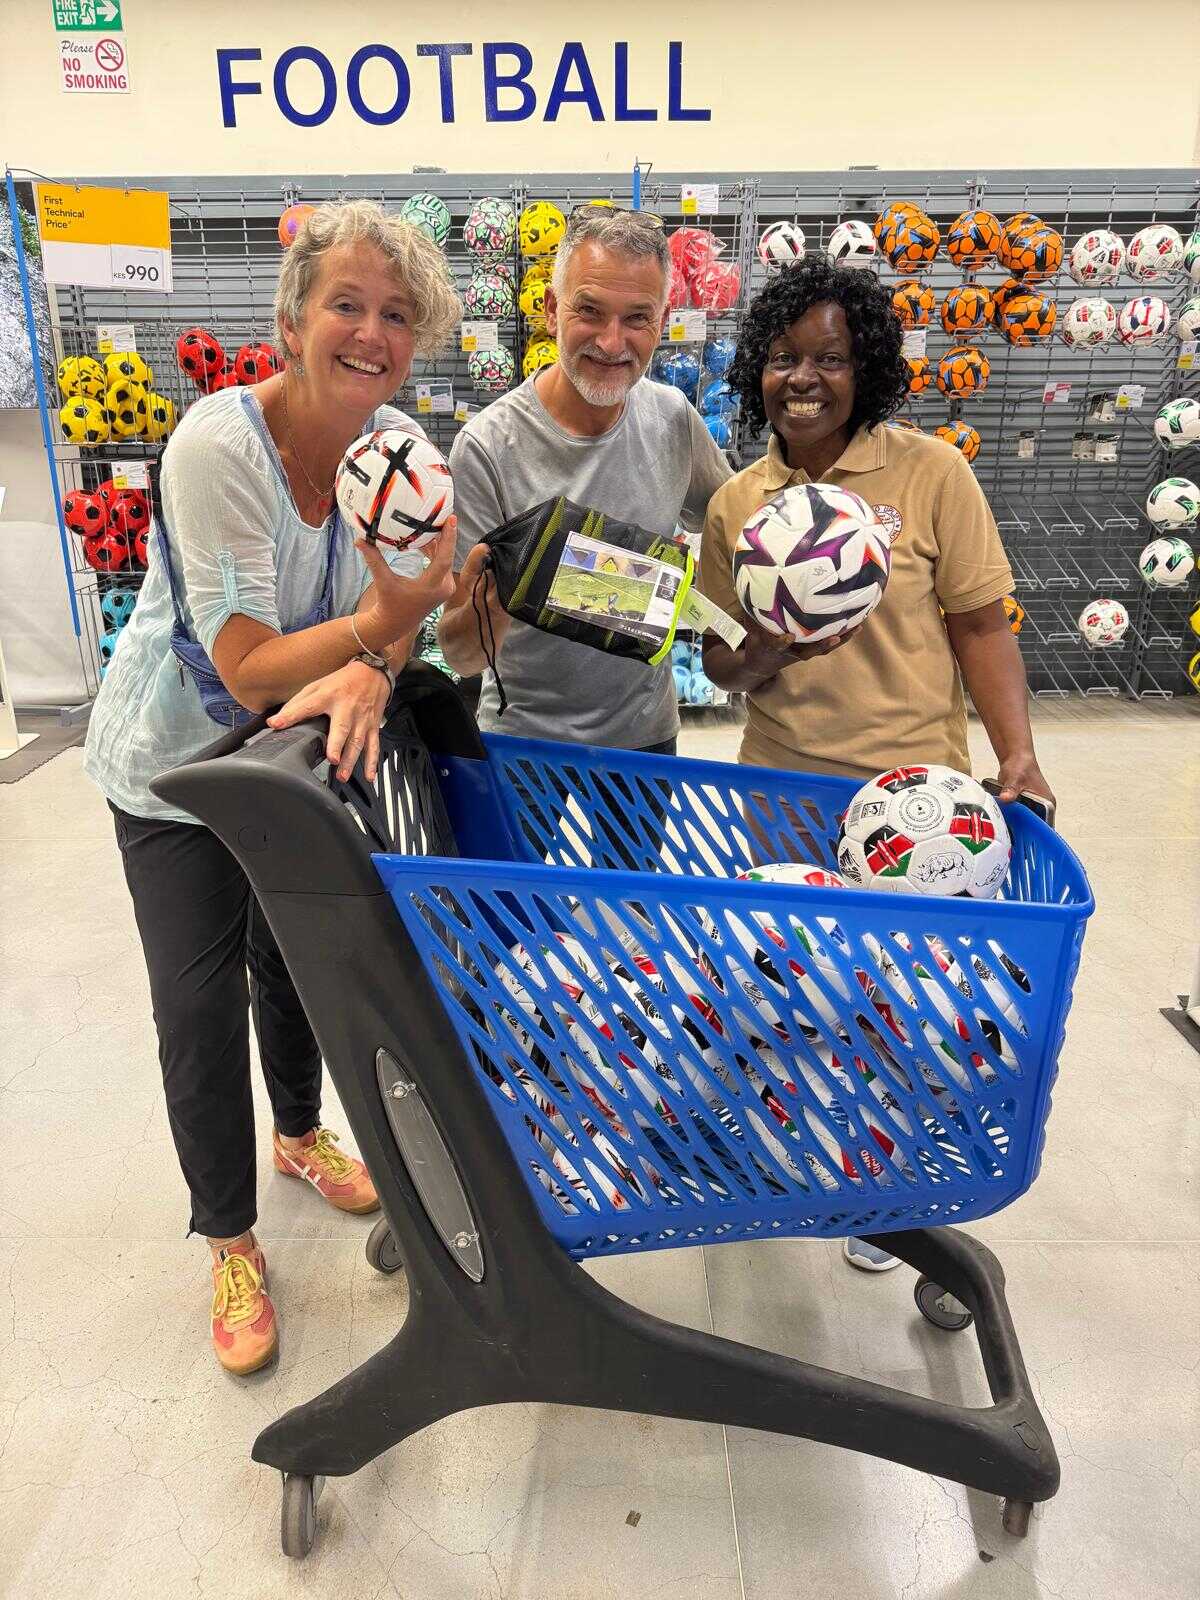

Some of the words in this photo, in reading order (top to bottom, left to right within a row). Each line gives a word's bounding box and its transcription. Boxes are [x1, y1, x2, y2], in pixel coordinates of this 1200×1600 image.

[55, 0, 78, 11] FIRE
[57, 11, 79, 26] EXIT
[61, 40, 94, 53] Please
[63, 58, 81, 71] NO
[65, 74, 127, 89] SMOKING
[216, 41, 711, 128] FOOTBALL
[44, 195, 63, 205] First
[45, 208, 85, 219] Technical
[125, 264, 159, 281] 990
